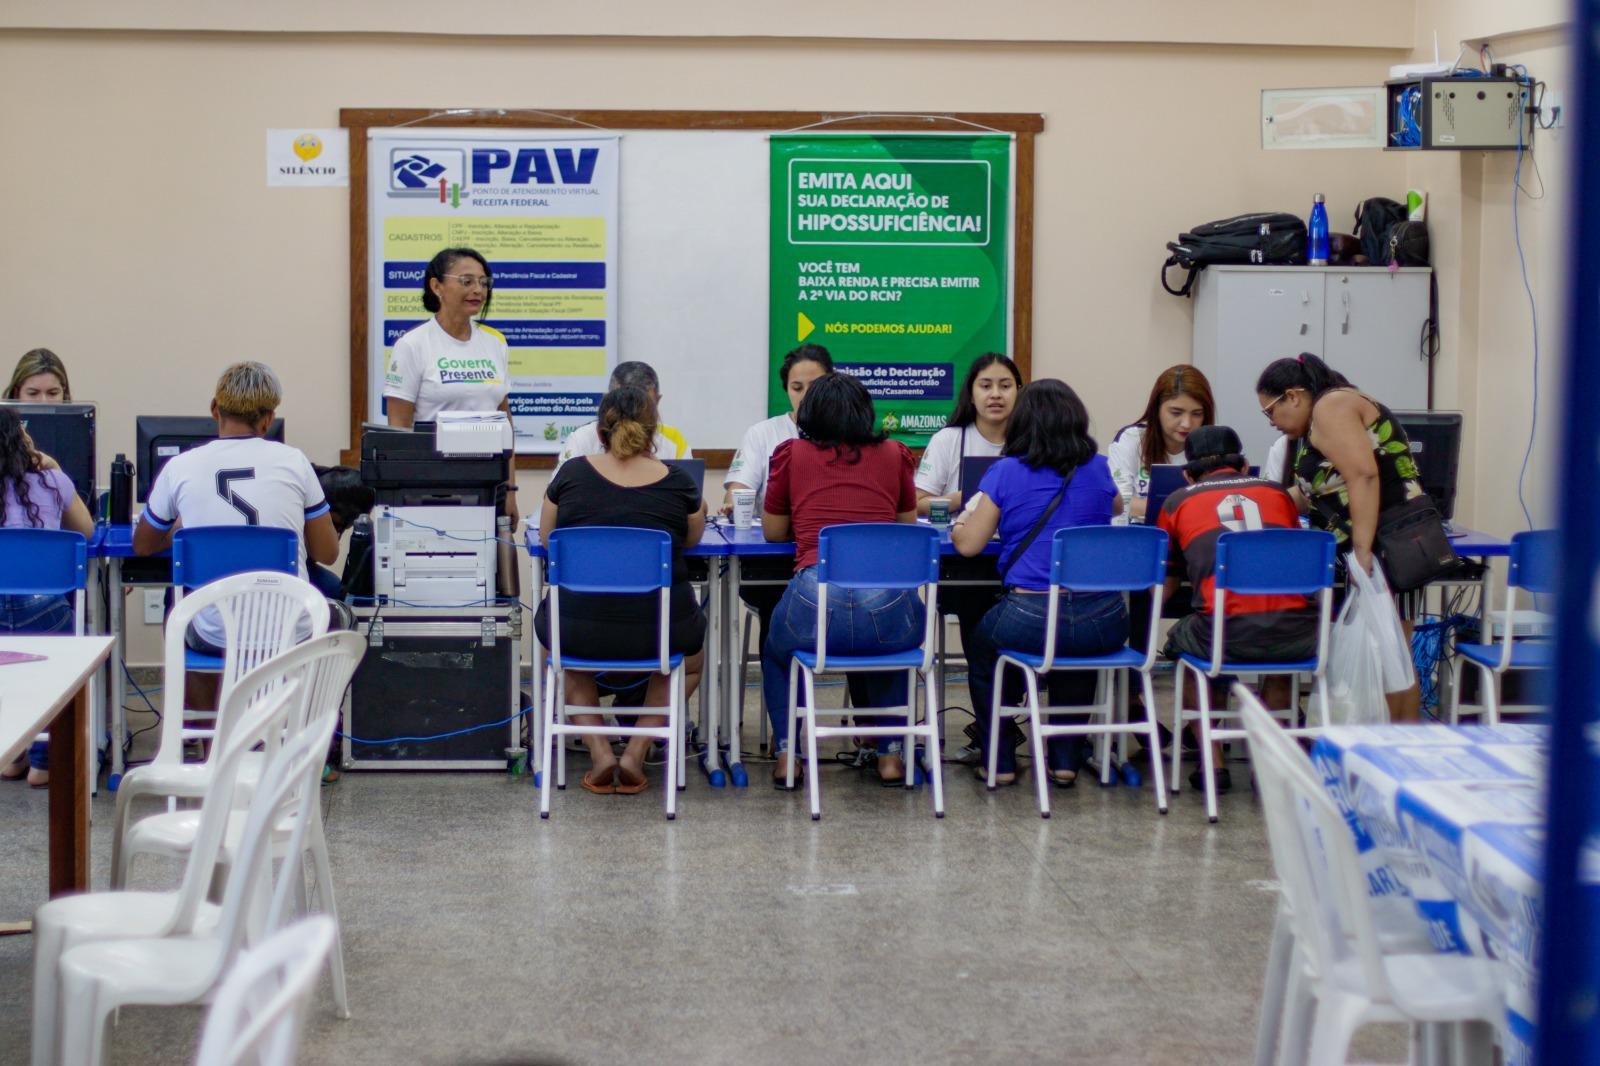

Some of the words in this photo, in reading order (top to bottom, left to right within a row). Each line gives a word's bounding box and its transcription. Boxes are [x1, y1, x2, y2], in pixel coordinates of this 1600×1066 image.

[279, 165, 336, 175] SILÊNCIO
[472, 148, 600, 184] PAV
[798, 172, 857, 189] EMITA
[861, 173, 912, 190] AQUI
[512, 188, 567, 196] ATENDIMENTO
[569, 188, 600, 196] VIRTUAL
[798, 194, 828, 208] SUA
[831, 192, 928, 211] DECLARAÇÃO
[931, 195, 949, 208] DE
[798, 211, 982, 232] HIPOSSUFICIÊNCIA!
[388, 233, 442, 241] CADASTROS
[798, 260, 833, 273] VOCÊ
[836, 262, 860, 273] TEM
[798, 276, 836, 287] BAIXA
[838, 276, 879, 288] RENDA
[882, 277, 888, 288] E
[890, 277, 938, 288] PRECISA
[941, 277, 980, 288] EMITIR
[798, 290, 808, 301] A
[826, 290, 846, 301] VIA
[850, 290, 868, 302] DO
[870, 290, 902, 302] RCN?
[825, 321, 849, 333] NÓS
[851, 323, 905, 333] PODEMOS
[907, 323, 952, 333] AJUDAR!
[440, 369, 495, 380] Presente
[874, 367, 888, 376] de
[889, 367, 946, 378] Declaração
[535, 396, 575, 404] oferecidos
[576, 397, 593, 406] pela
[900, 415, 947, 428] AMAZONAS
[1216, 495, 1263, 533] 9
